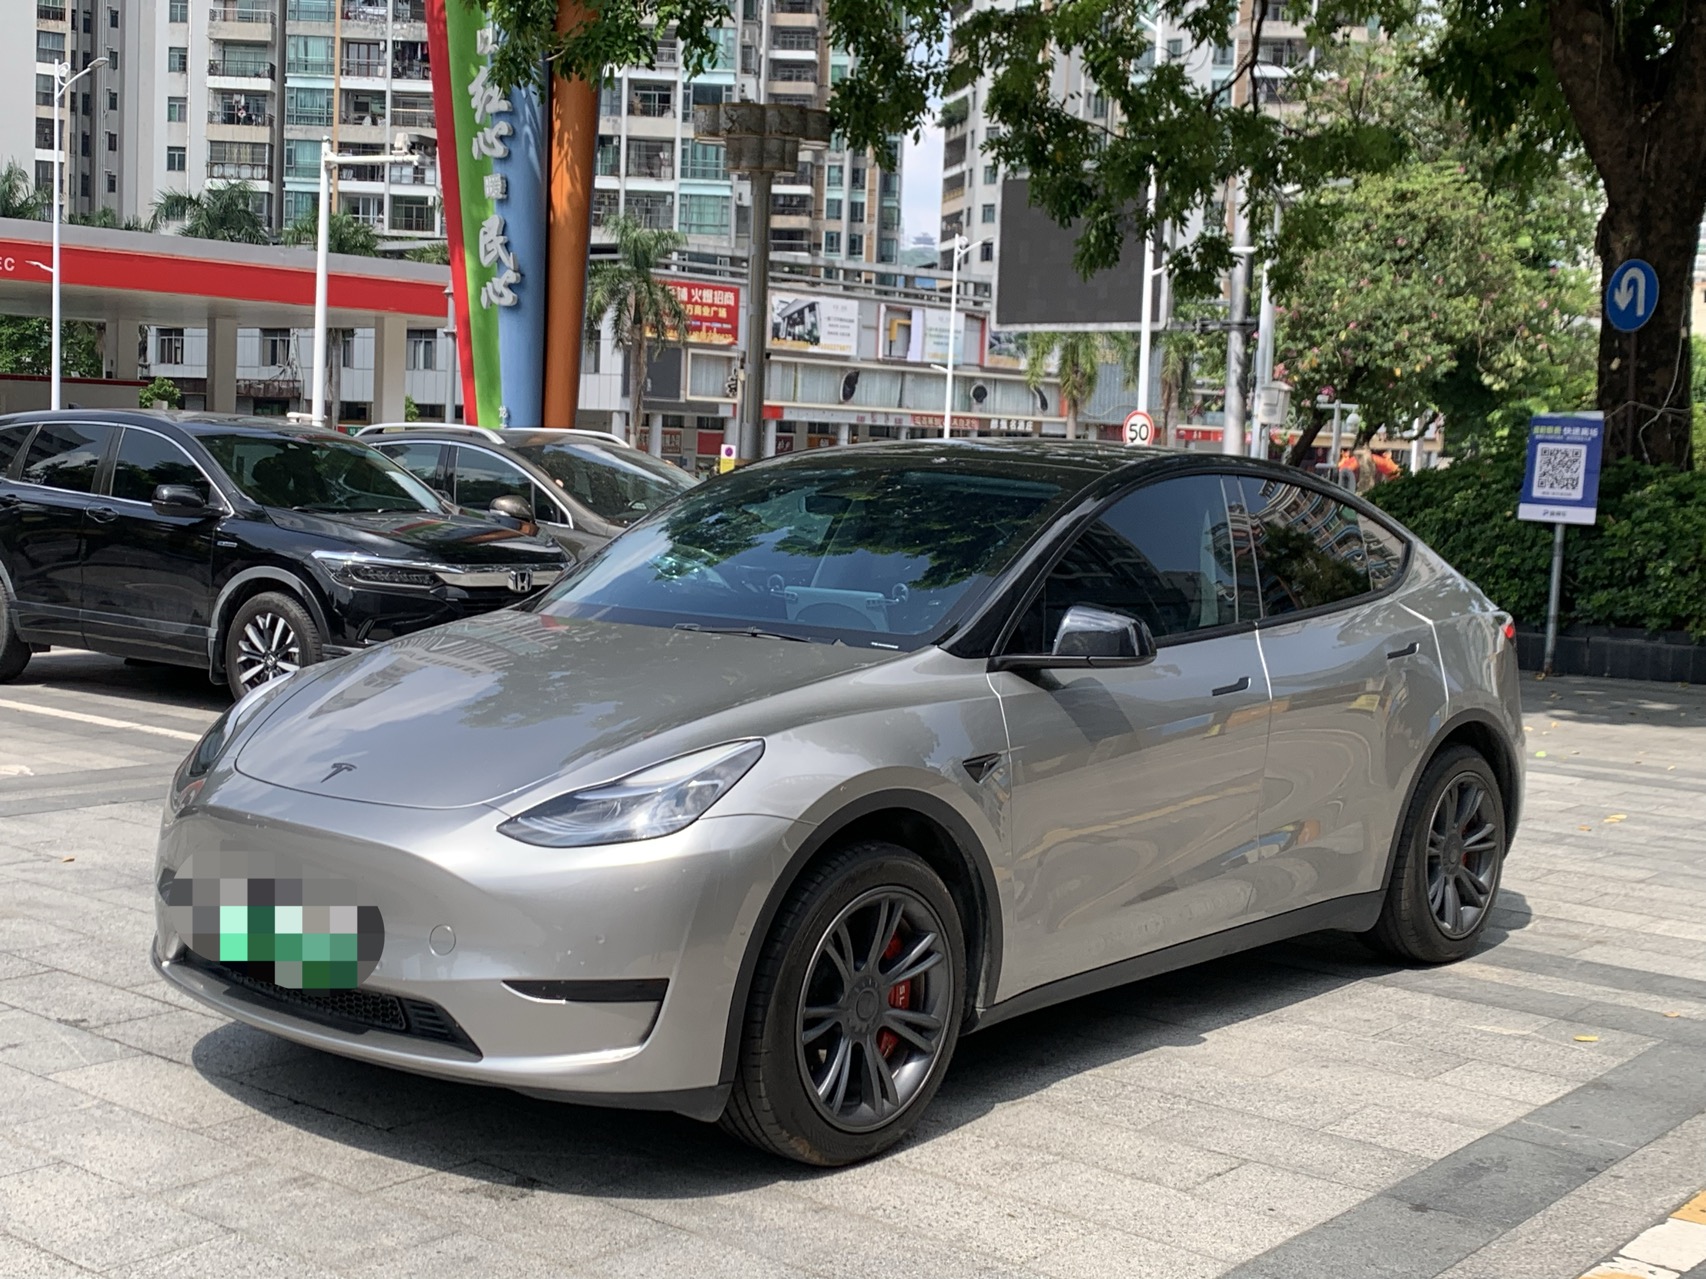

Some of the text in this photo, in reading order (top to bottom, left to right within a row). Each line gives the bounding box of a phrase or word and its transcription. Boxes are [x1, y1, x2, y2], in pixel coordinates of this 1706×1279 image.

[691, 287, 735, 306] 火爆招商
[680, 303, 727, 318] 方商业广场
[1129, 423, 1149, 442] 50
